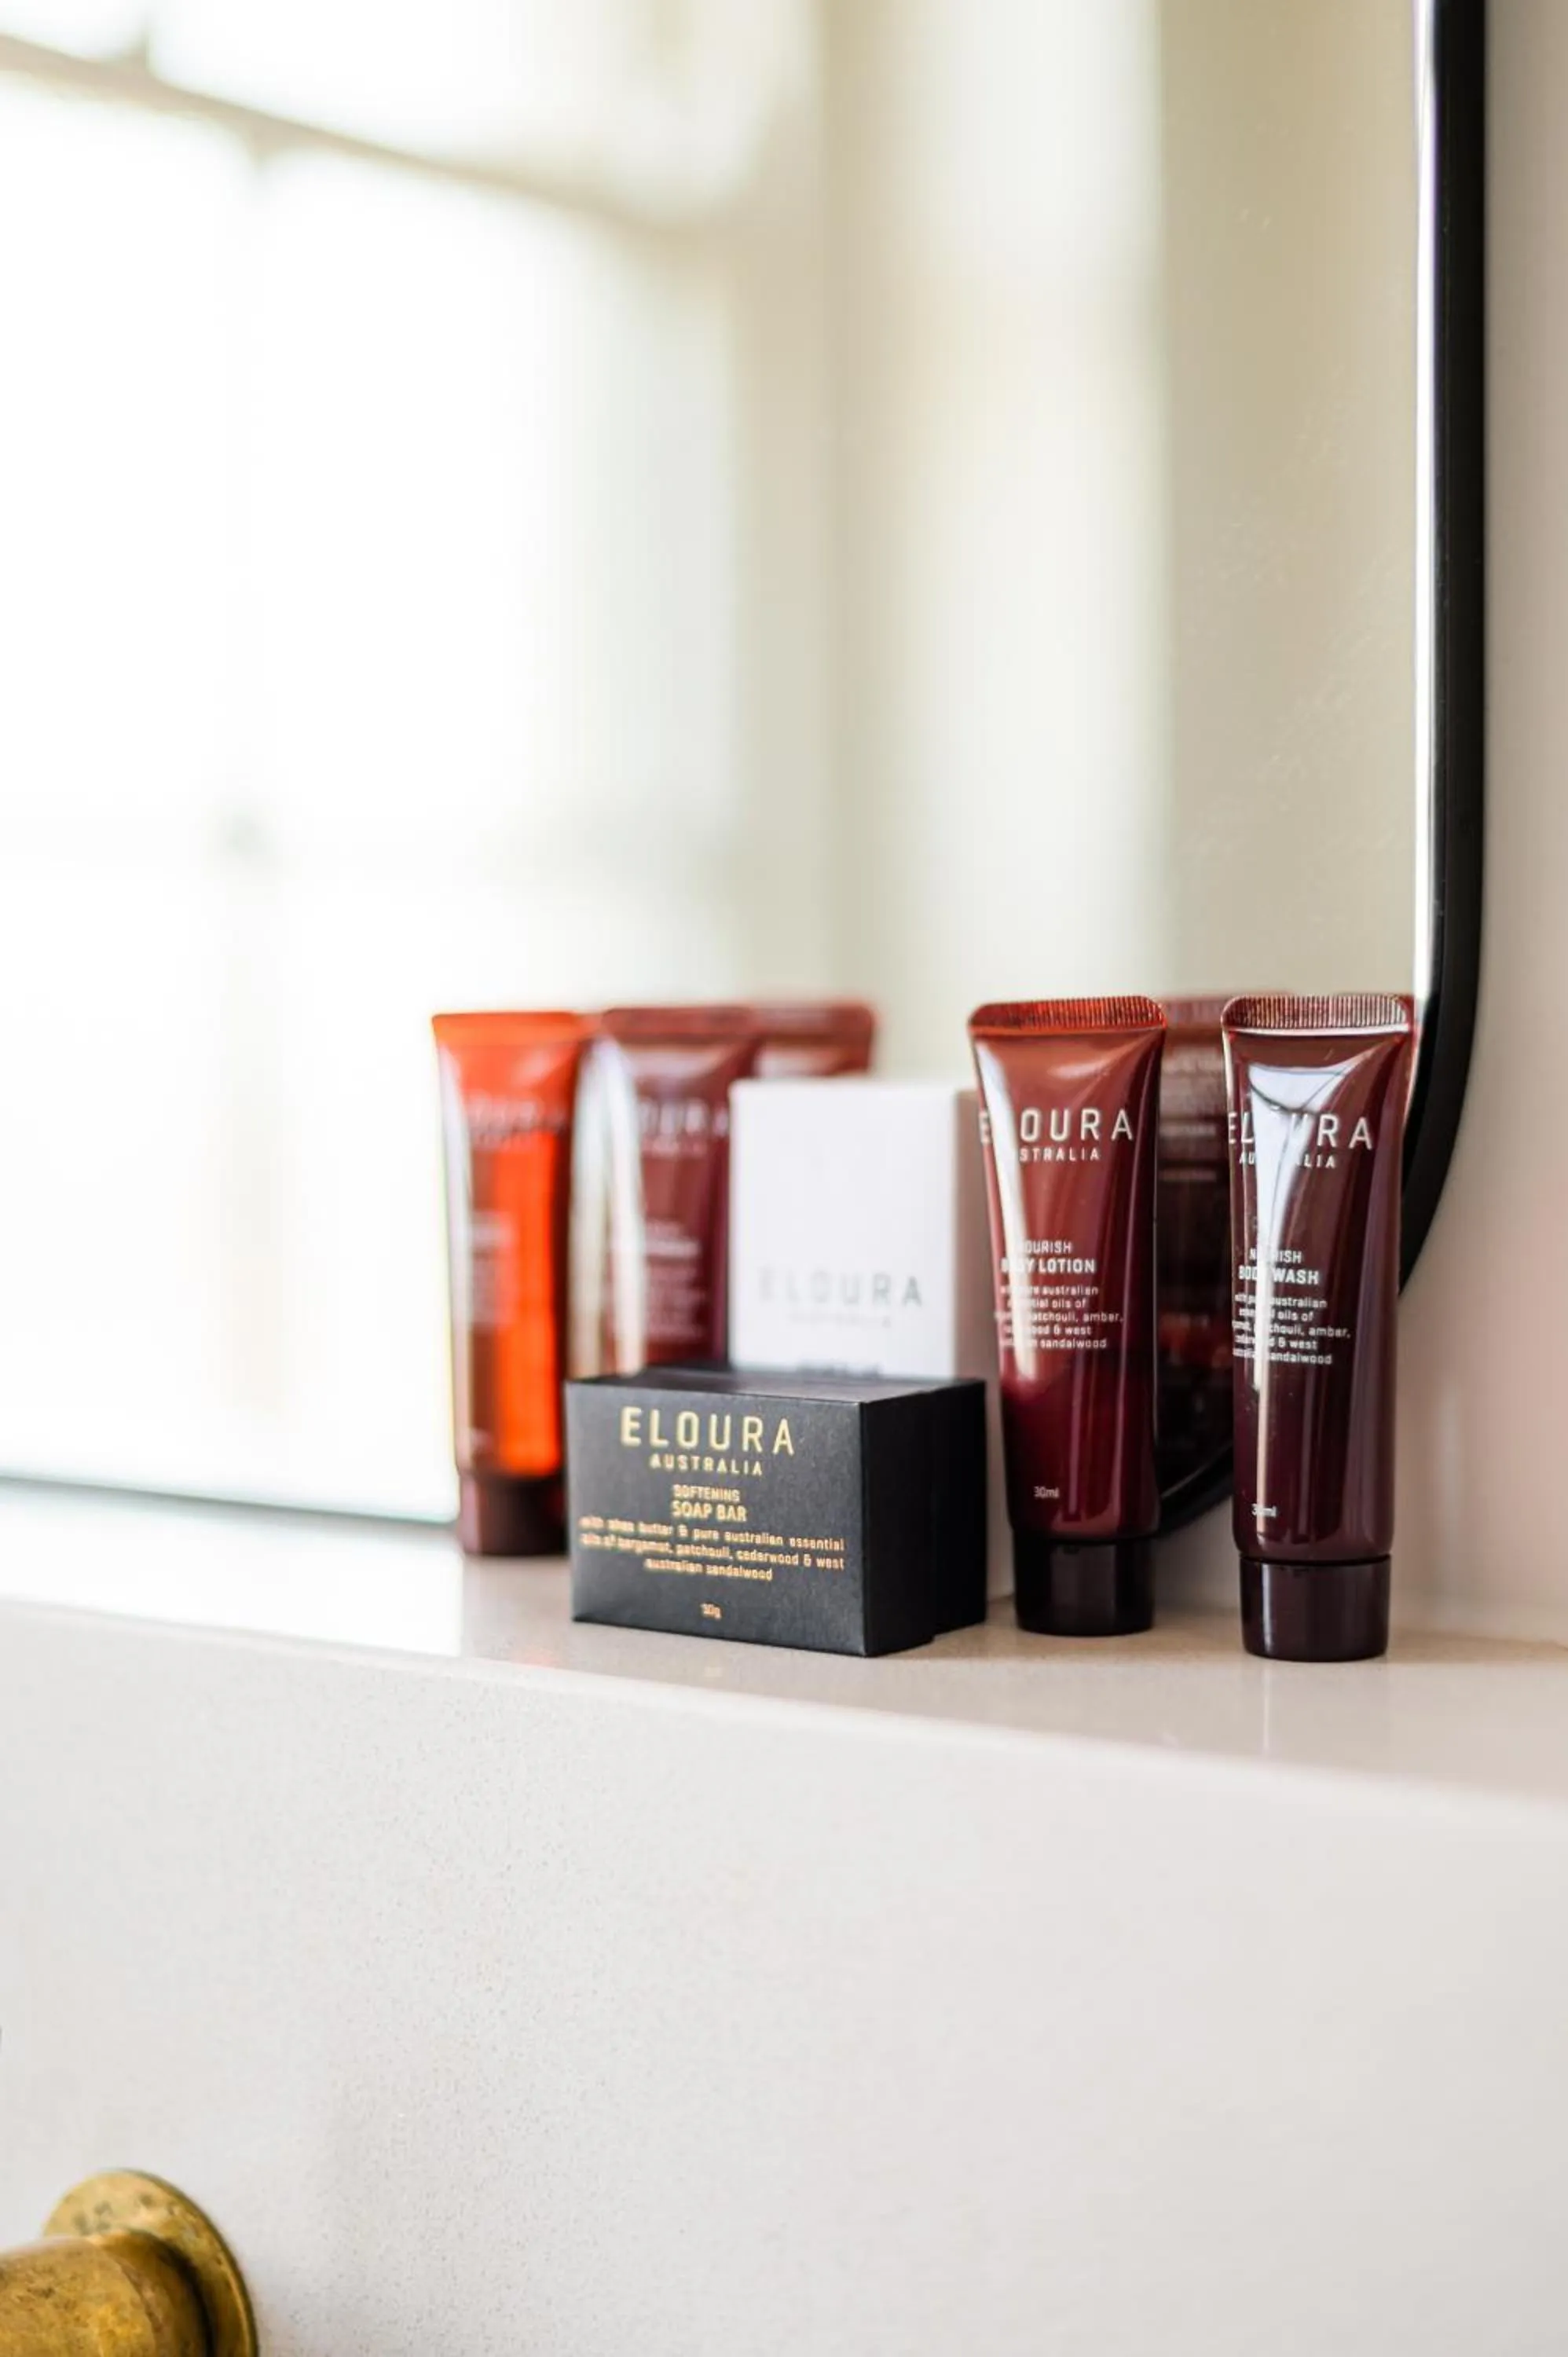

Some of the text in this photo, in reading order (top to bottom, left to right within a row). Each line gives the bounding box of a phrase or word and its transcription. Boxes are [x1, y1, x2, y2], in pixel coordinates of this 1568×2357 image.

[979, 1107, 1134, 1143] EOURA
[1228, 1112, 1373, 1151] ELRA
[1020, 1147, 1101, 1162] STRALIA
[1020, 1240, 1073, 1255] OURISH
[1038, 1259, 1097, 1274] LOTION
[1273, 1267, 1320, 1285] WASH
[1042, 1285, 1099, 1296] australian
[1051, 1299, 1072, 1309] oils
[1075, 1299, 1087, 1309] of
[1028, 1312, 1124, 1323] atchouli, amber,
[1277, 1310, 1299, 1321] oils
[1301, 1311, 1314, 1321] of
[1064, 1325, 1092, 1336] west
[1309, 1326, 1351, 1339] amber,
[1040, 1338, 1108, 1349] sandalwood
[1289, 1339, 1318, 1351] west
[621, 1406, 794, 1455] ELOURA
[650, 1453, 763, 1476] AUSTRALIA
[672, 1483, 741, 1502] SOFTENING
[672, 1499, 748, 1522] SOAP BAR
[693, 1528, 720, 1541] pure
[724, 1530, 783, 1546] australian
[789, 1536, 845, 1551] essential
[736, 1549, 800, 1566] cedarwood
[803, 1553, 812, 1567] &
[815, 1557, 845, 1571] west
[705, 1563, 774, 1582] sandalwood
